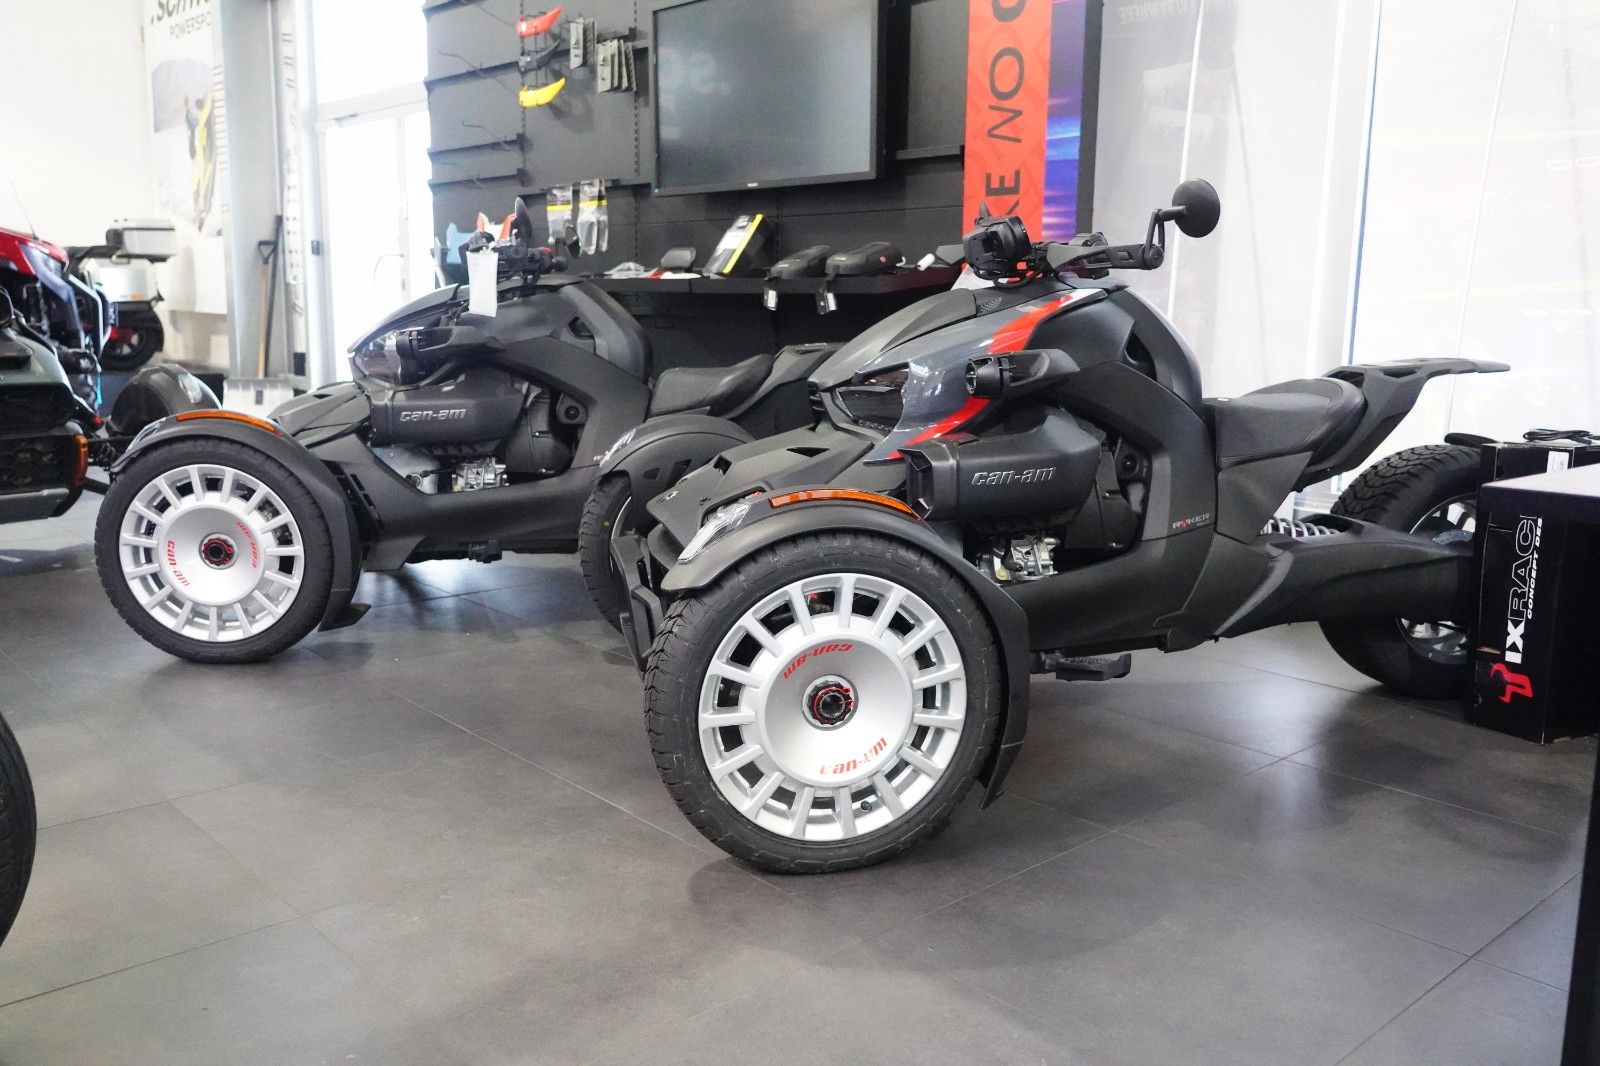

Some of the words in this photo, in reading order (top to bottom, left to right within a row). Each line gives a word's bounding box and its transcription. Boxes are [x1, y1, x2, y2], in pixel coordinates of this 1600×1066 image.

[987, 46, 1025, 143] NO
[400, 408, 467, 422] can-am
[971, 467, 1057, 486] can-am
[1504, 515, 1538, 664] IXRAC
[1527, 550, 1538, 620] CONCEPT
[783, 642, 854, 680] can-am
